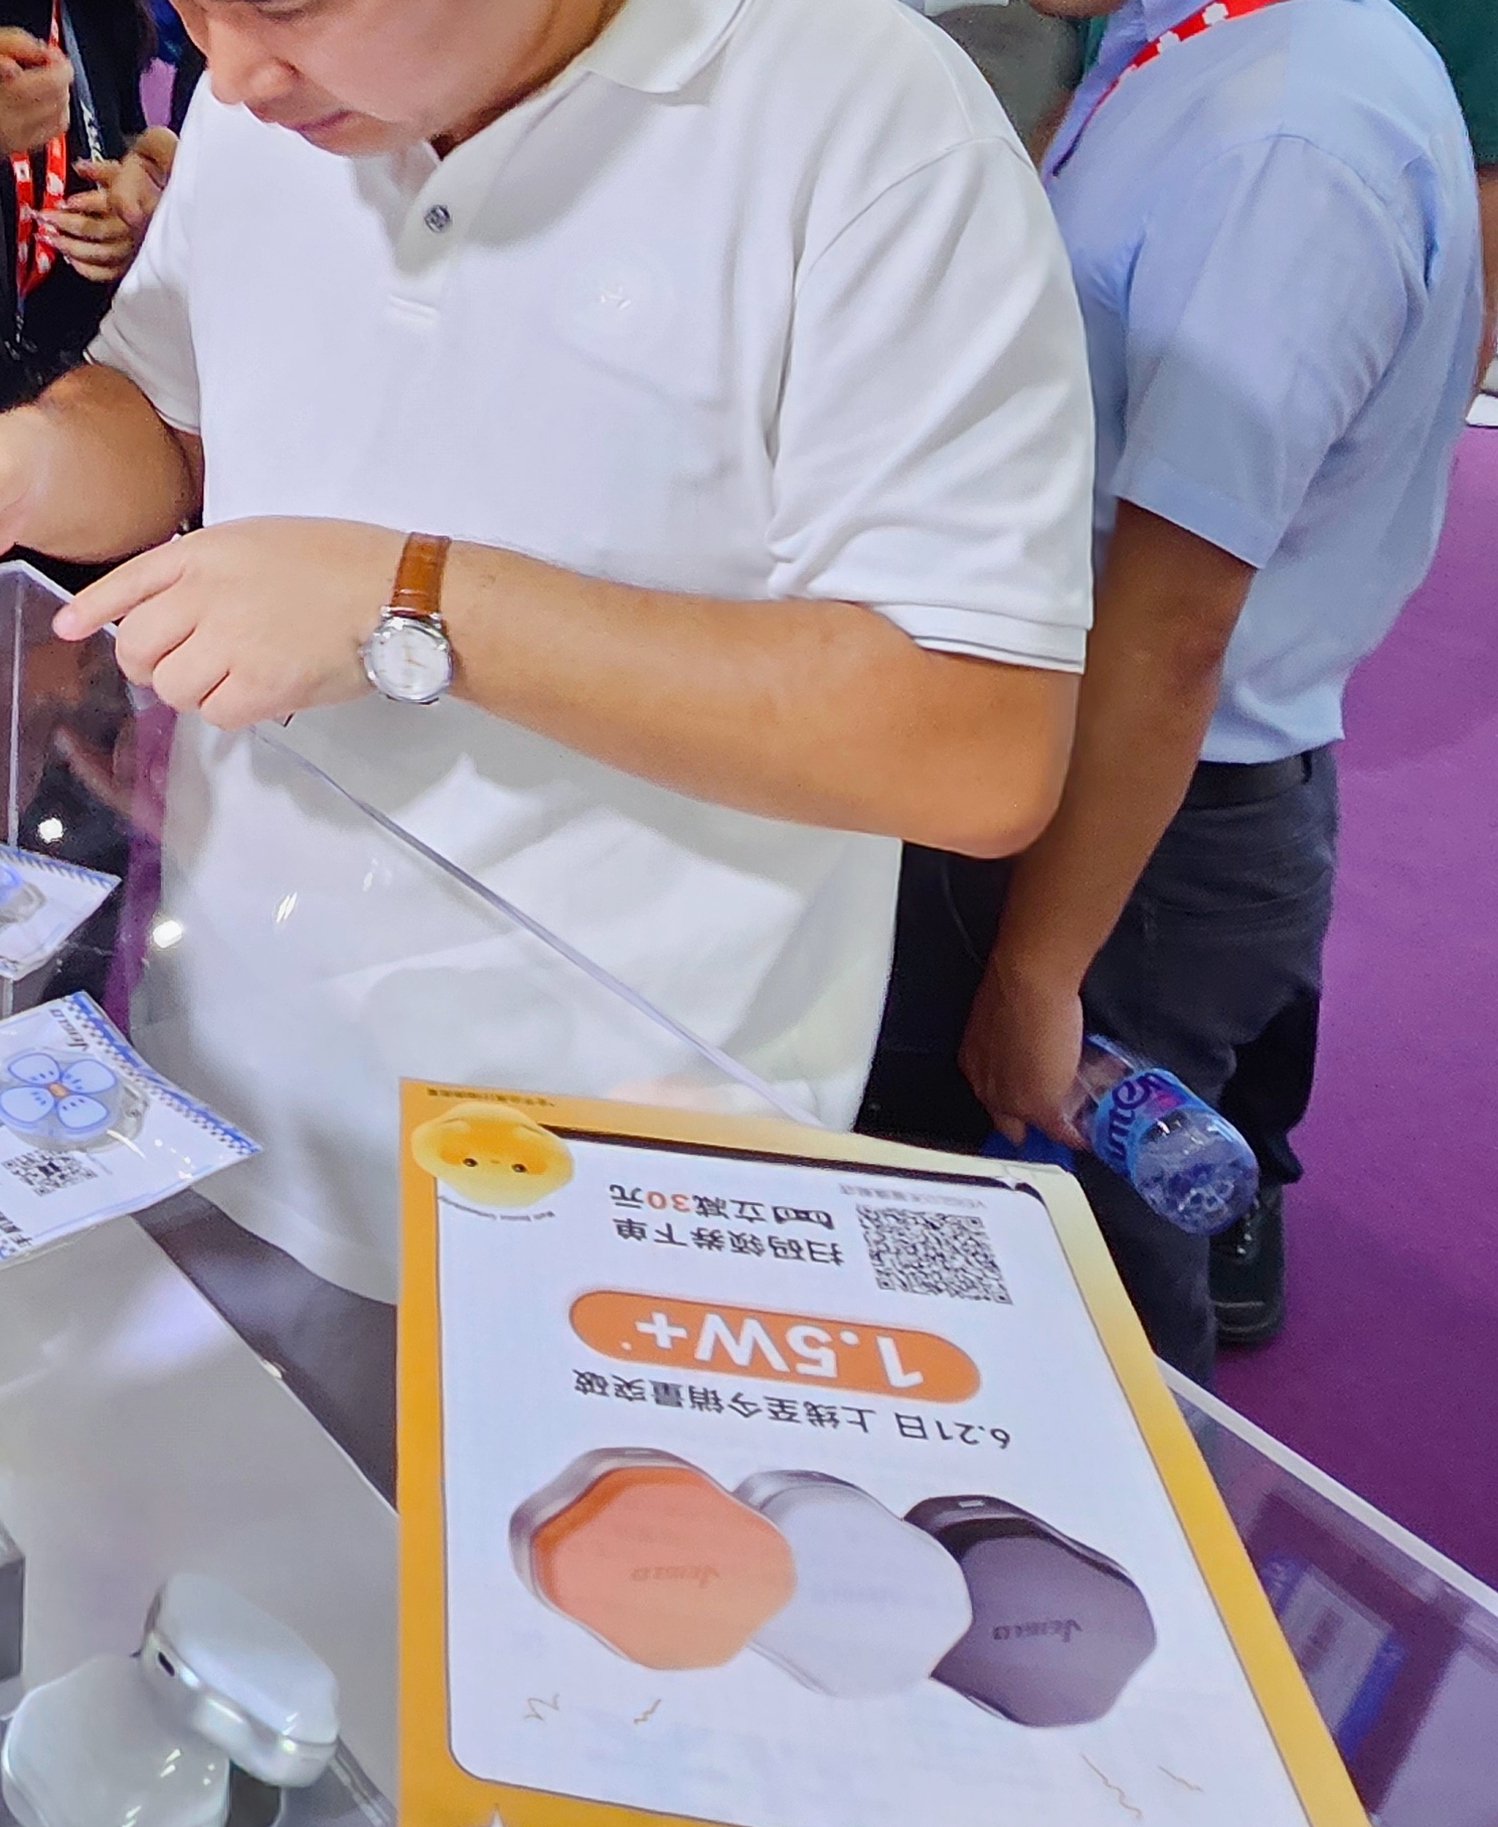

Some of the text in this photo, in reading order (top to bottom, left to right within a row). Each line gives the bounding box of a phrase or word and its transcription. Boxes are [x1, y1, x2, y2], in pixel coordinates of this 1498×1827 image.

[609, 1183, 768, 1224] 立减30元
[612, 1217, 844, 1267] 扫码领券下单
[573, 1368, 877, 1434] 上线至今销量突破
